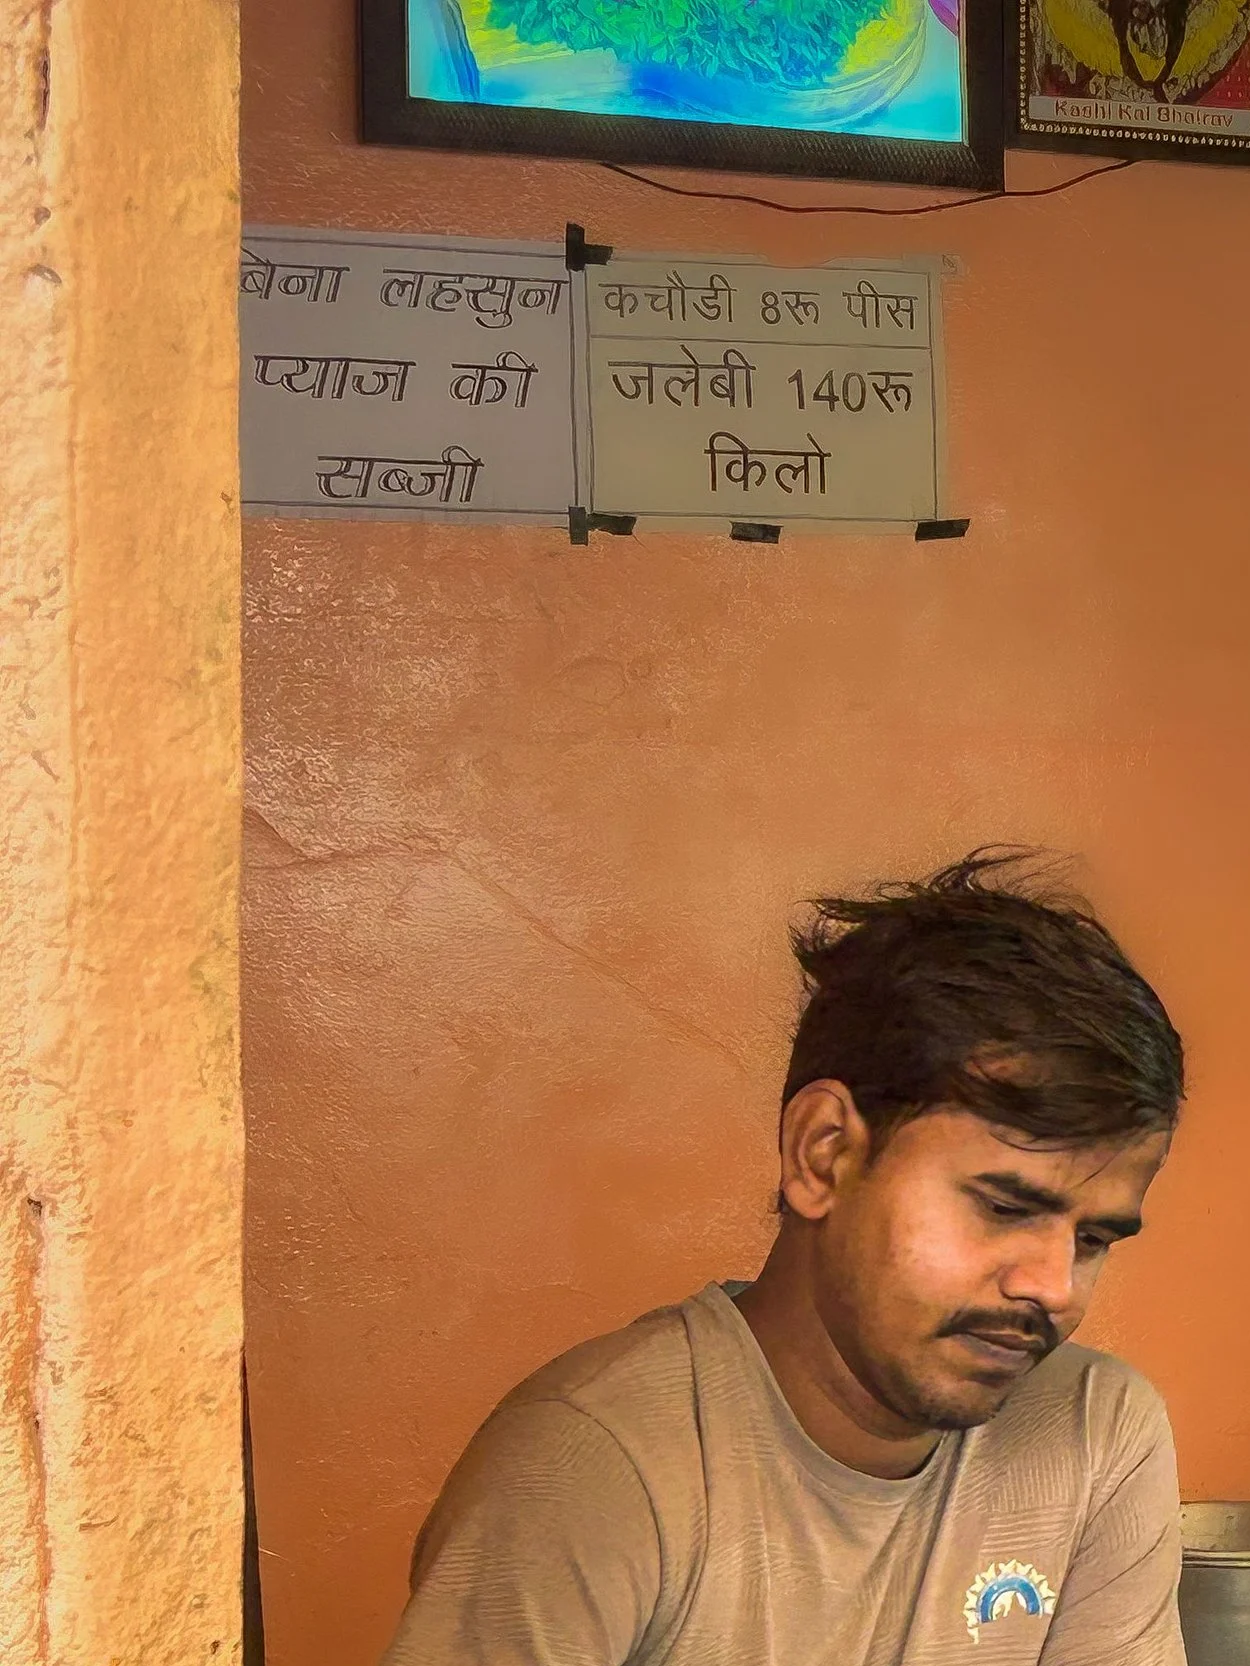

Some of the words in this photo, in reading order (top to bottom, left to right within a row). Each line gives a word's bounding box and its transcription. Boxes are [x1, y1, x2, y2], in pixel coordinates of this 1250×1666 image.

[380, 266, 569, 328] लहसुन
[761, 290, 820, 326] 8रू
[842, 280, 918, 330] पीस
[253, 354, 417, 404] प्याज
[449, 351, 539, 408] की
[608, 344, 757, 408] जलेबी
[787, 368, 914, 414] 140रू
[316, 445, 485, 503] सब्जी
[703, 430, 832, 495] किलो
